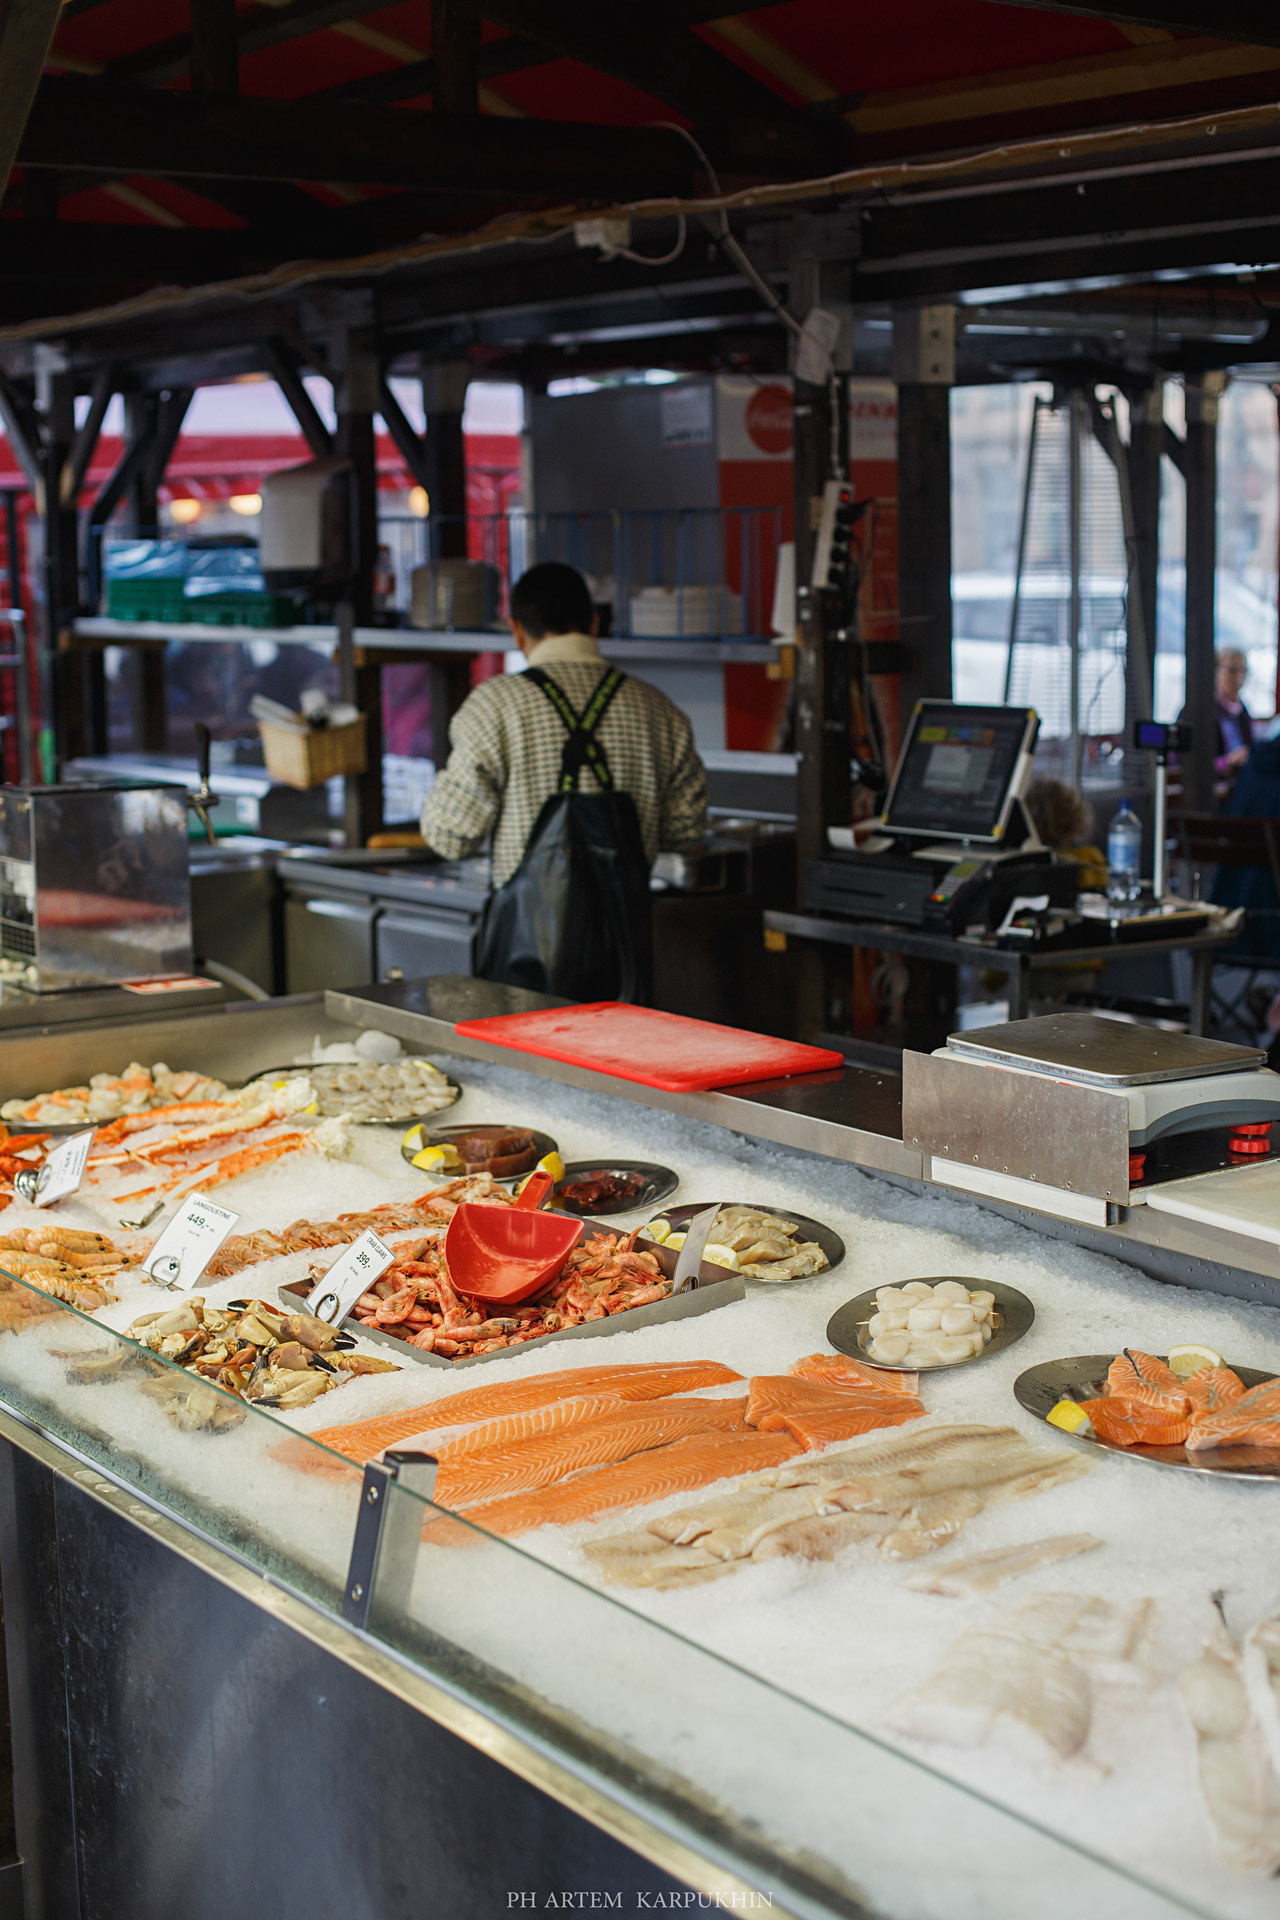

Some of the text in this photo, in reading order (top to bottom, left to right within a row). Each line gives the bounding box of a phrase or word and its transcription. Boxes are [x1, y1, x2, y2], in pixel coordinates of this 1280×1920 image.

[193, 1199, 231, 1220] LANGOUSTINE
[187, 1213, 209, 1229] 449,-
[366, 1237, 388, 1259] CRAB CLAWS
[356, 1251, 371, 1269] 399,-
